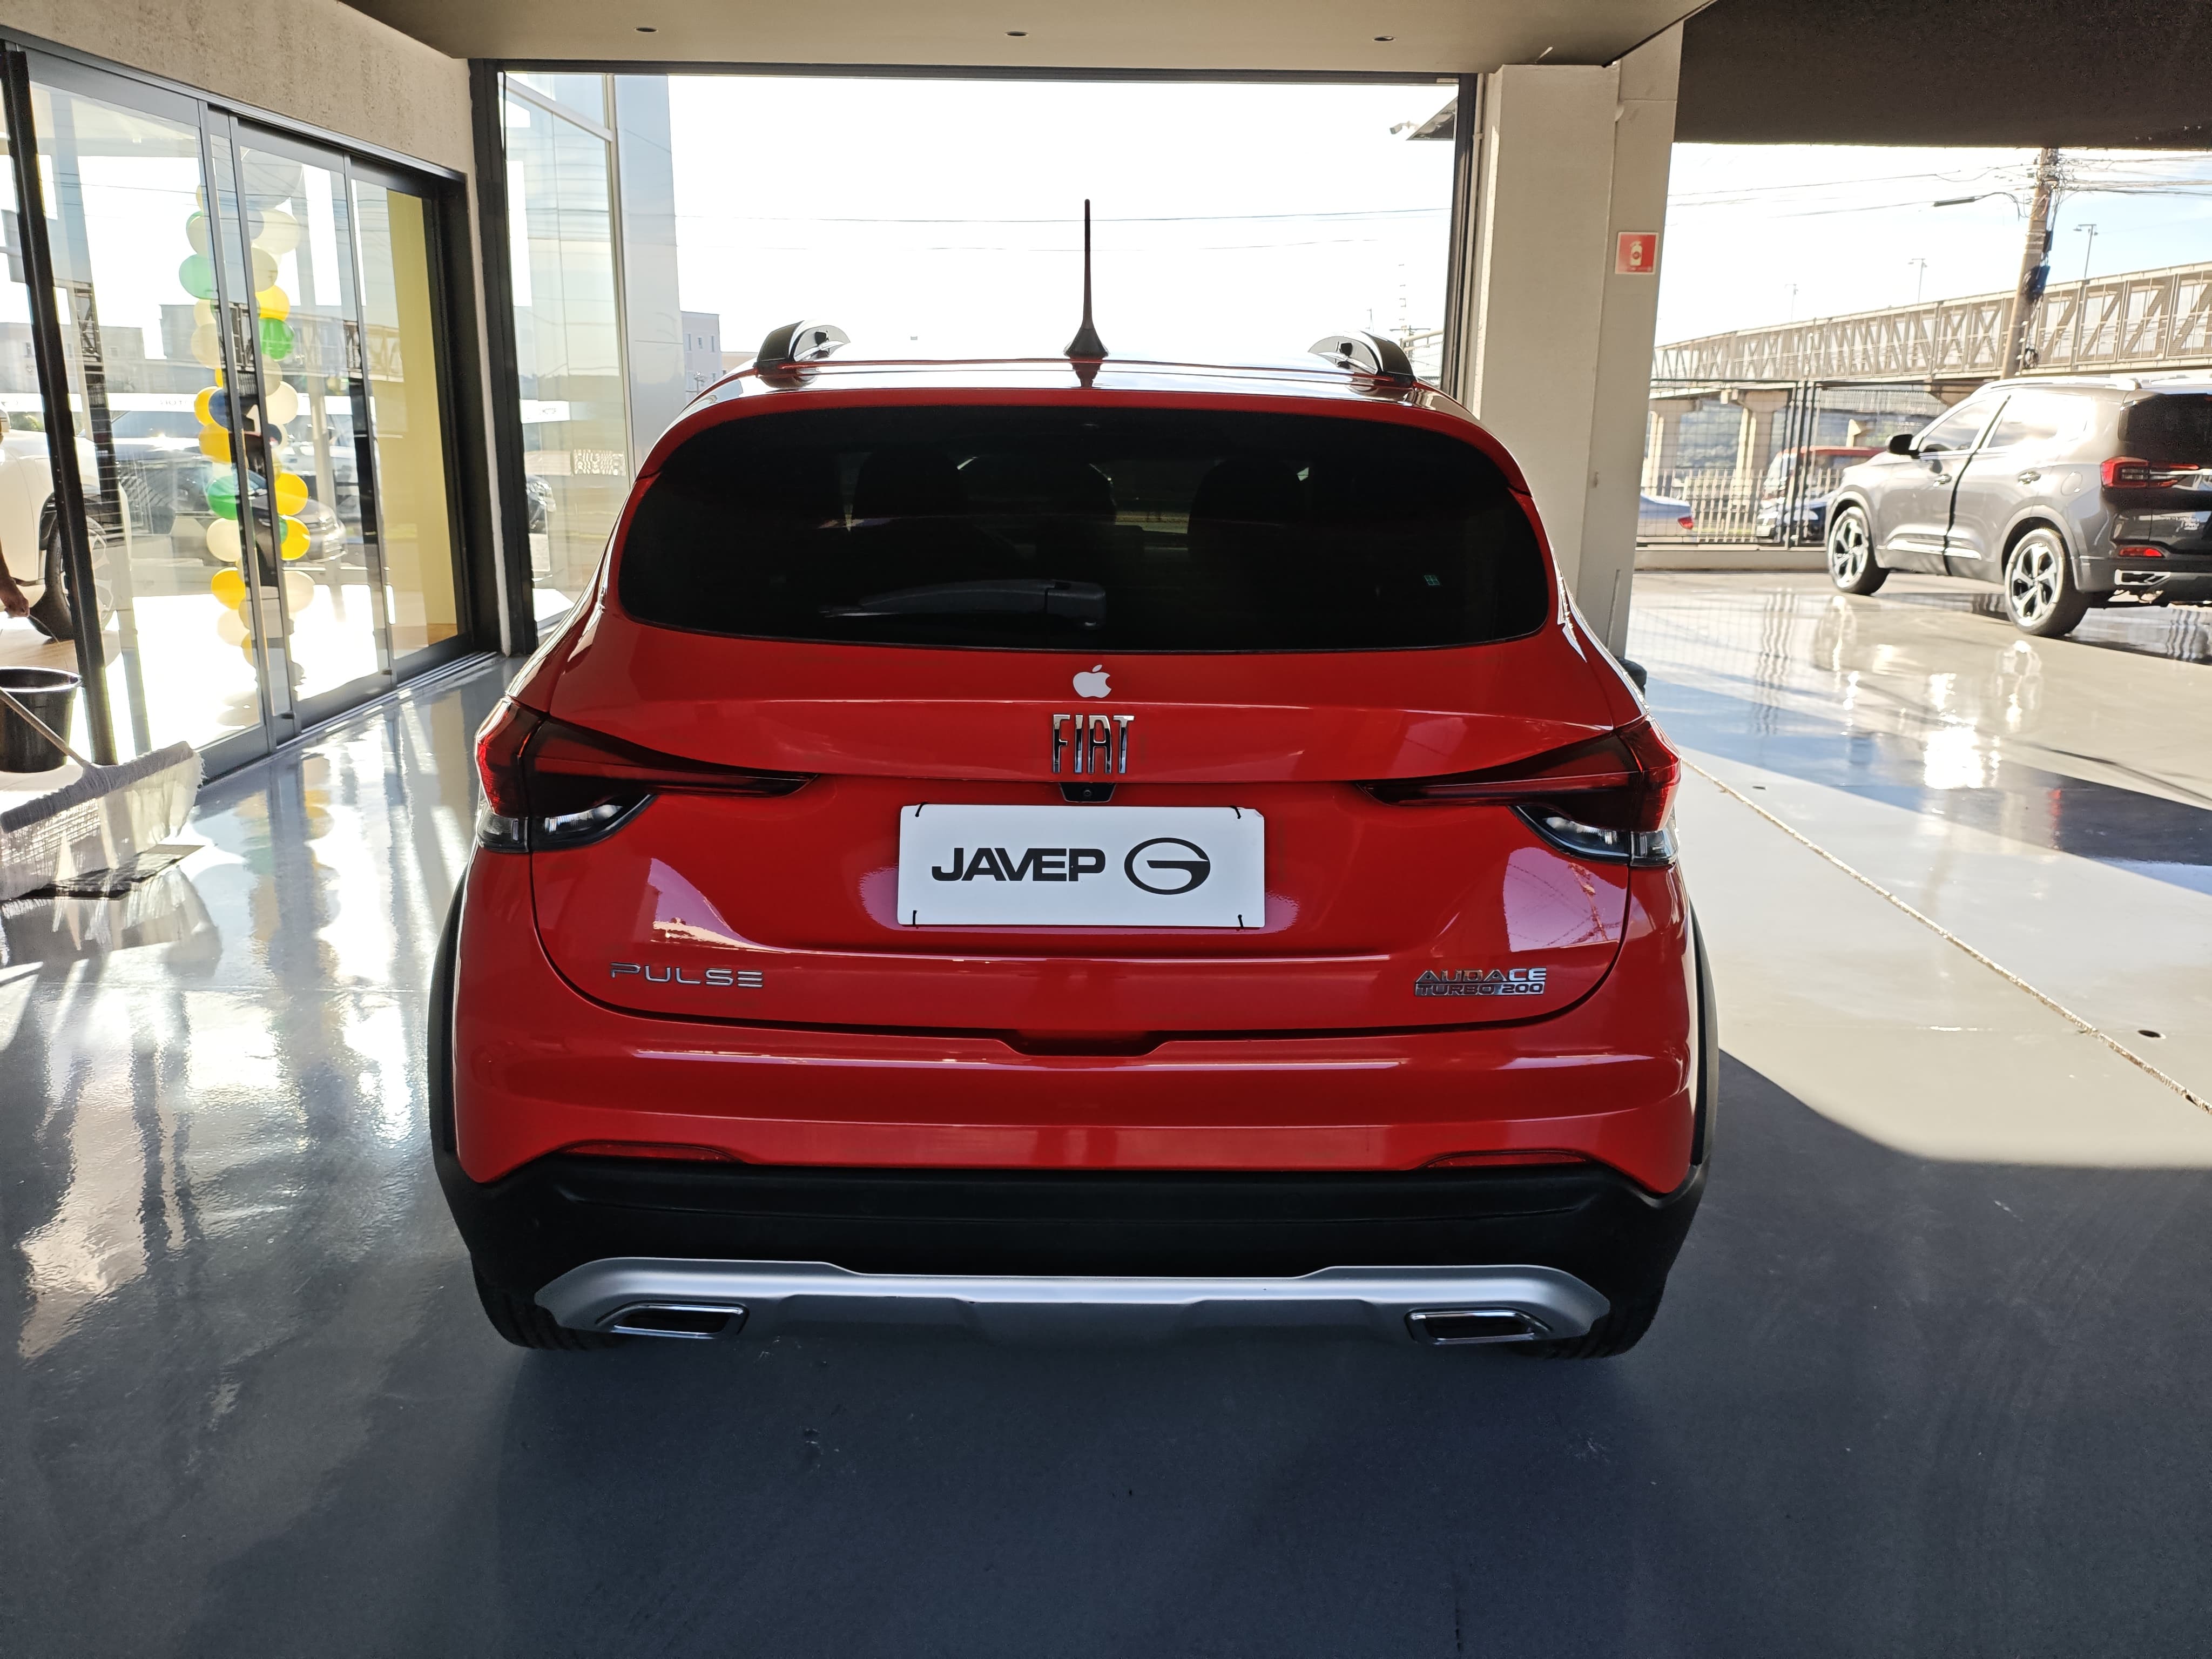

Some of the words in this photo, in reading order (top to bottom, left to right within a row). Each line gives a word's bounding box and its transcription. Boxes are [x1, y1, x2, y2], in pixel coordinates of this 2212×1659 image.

[1052, 713, 1135, 774] FIAT
[932, 847, 1106, 881] JAVEP
[610, 962, 764, 988] PULSE
[1415, 968, 1547, 983] AUDACE
[1417, 984, 1495, 995] TURBO
[1501, 983, 1544, 994] 200
